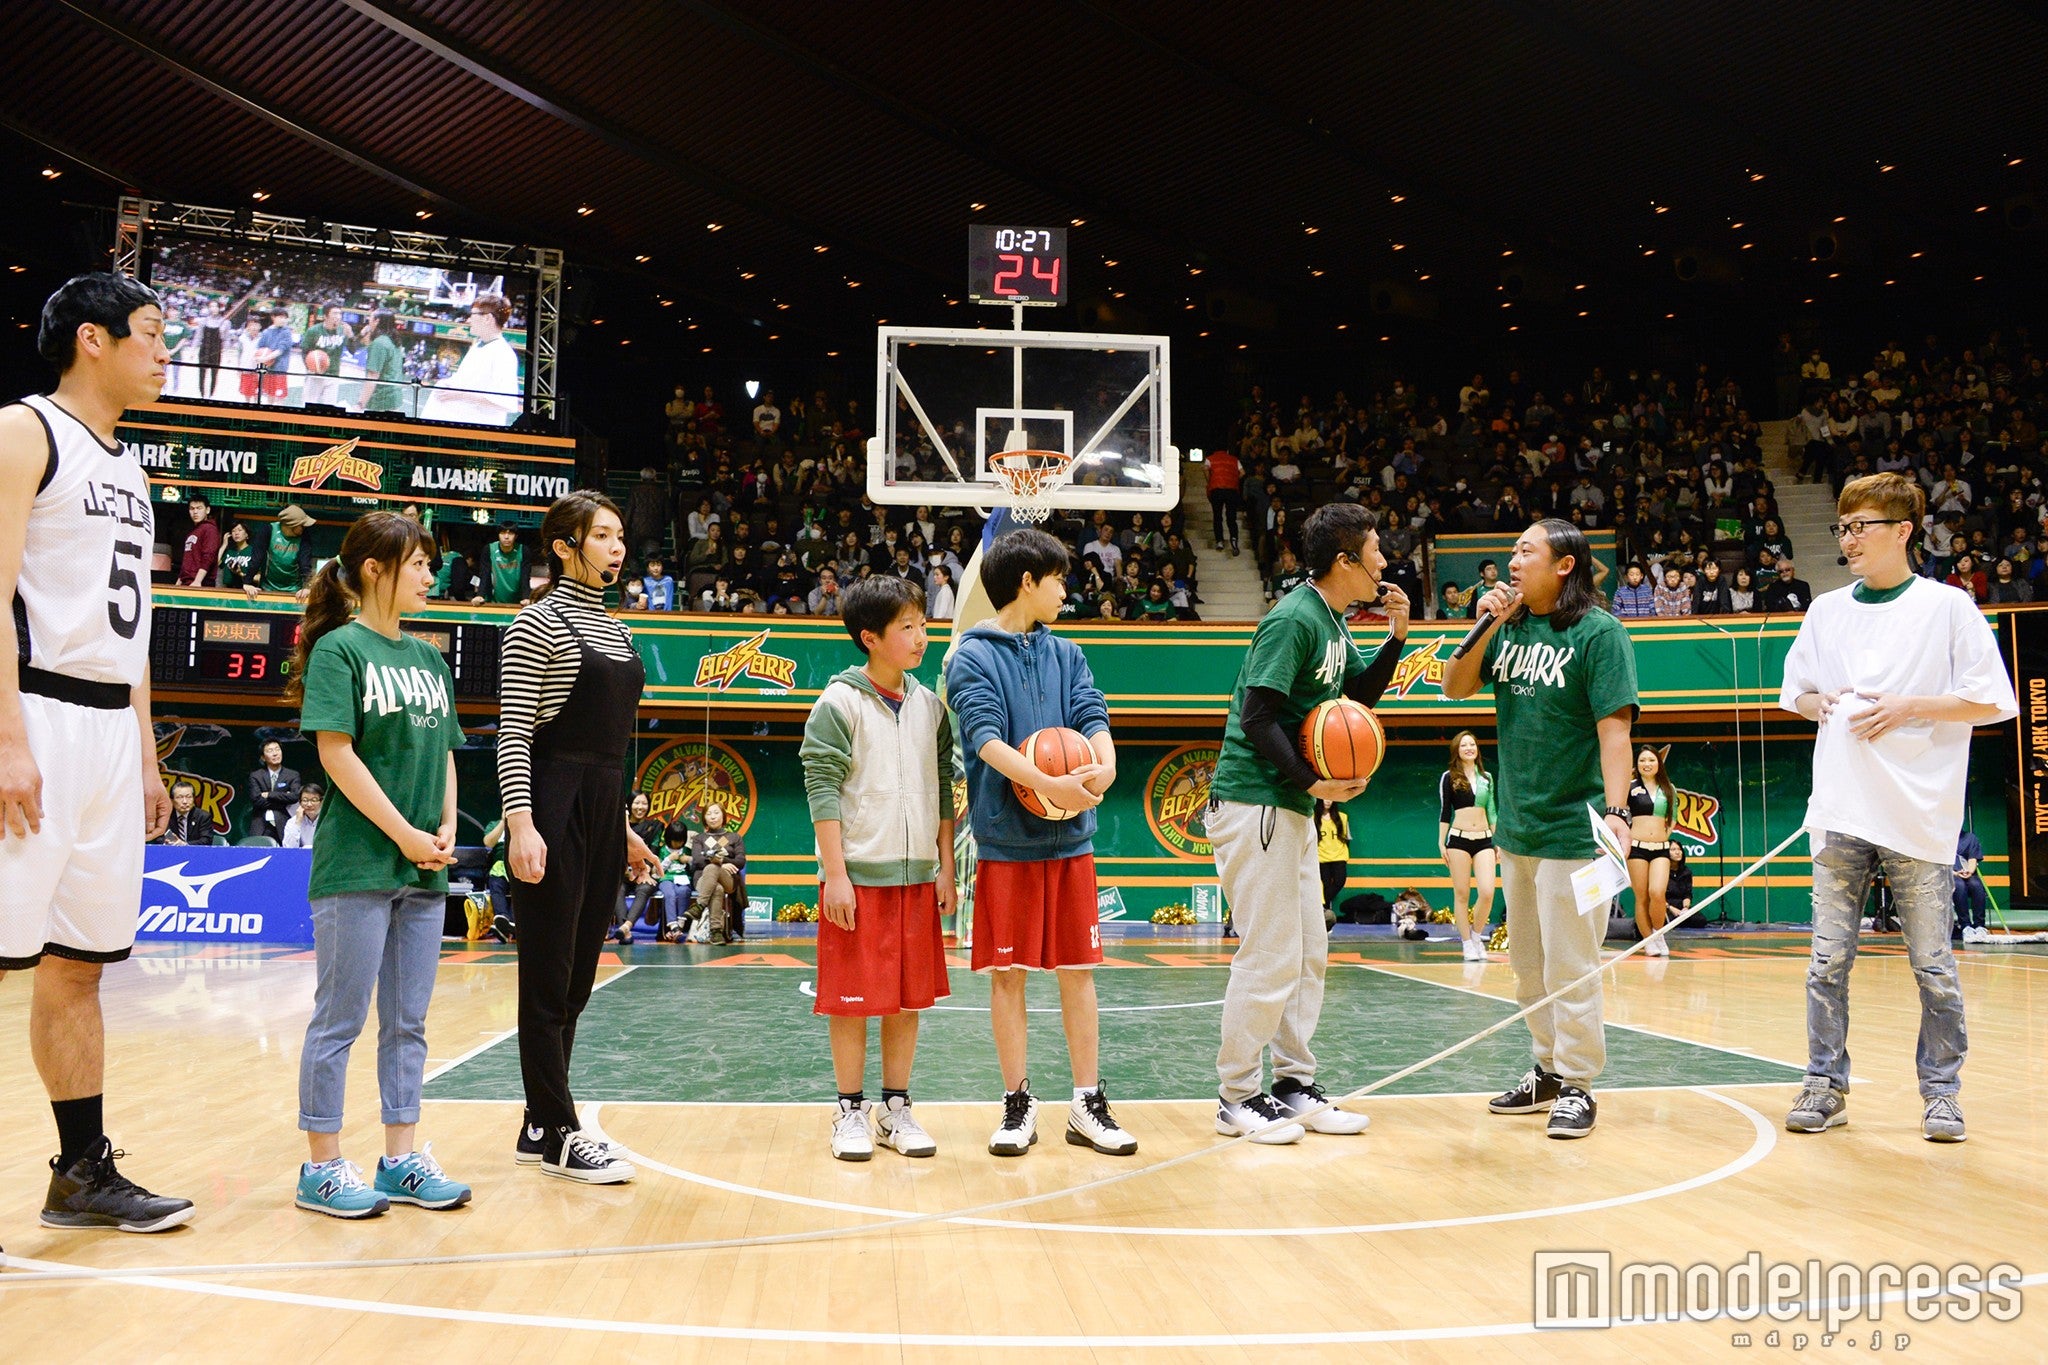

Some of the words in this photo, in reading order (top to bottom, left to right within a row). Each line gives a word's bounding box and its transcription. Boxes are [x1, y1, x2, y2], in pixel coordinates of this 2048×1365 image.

[995, 229, 1051, 252] 10:27
[994, 254, 1060, 296] 24
[127, 442, 173, 469] ARK
[186, 446, 258, 475] TOKYO
[289, 436, 384, 491] ALVARK
[411, 465, 493, 493] ALVARK
[504, 472, 570, 499] TOKYO
[352, 496, 379, 505] TOKYO
[107, 539, 143, 640] 5
[227, 653, 268, 679] 33
[694, 628, 797, 692] ALVARK
[1491, 640, 1575, 688] ALVARK
[759, 688, 789, 696] TOKYO
[2029, 678, 2048, 723] TOKYO
[408, 712, 439, 729] TOKYO
